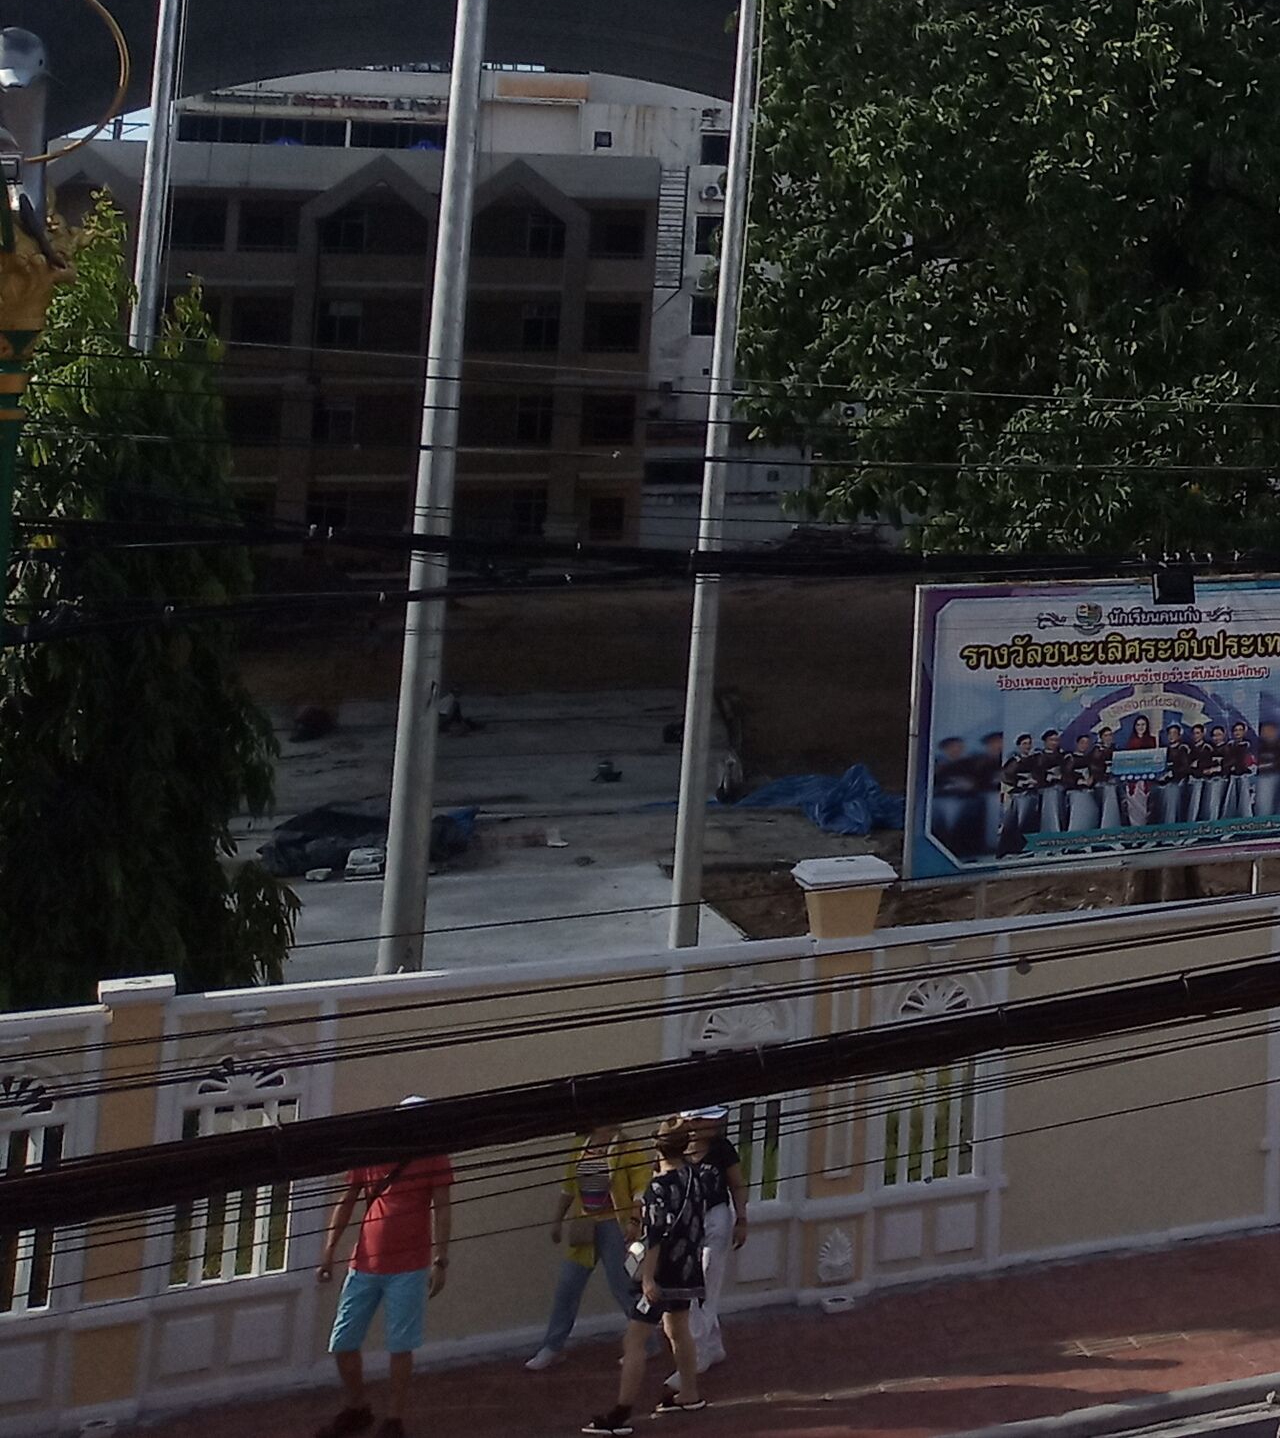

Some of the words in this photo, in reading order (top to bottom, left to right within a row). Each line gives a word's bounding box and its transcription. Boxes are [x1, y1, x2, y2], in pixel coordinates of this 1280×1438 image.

[1107, 605, 1203, 627] นักเรียนคนเก่ง
